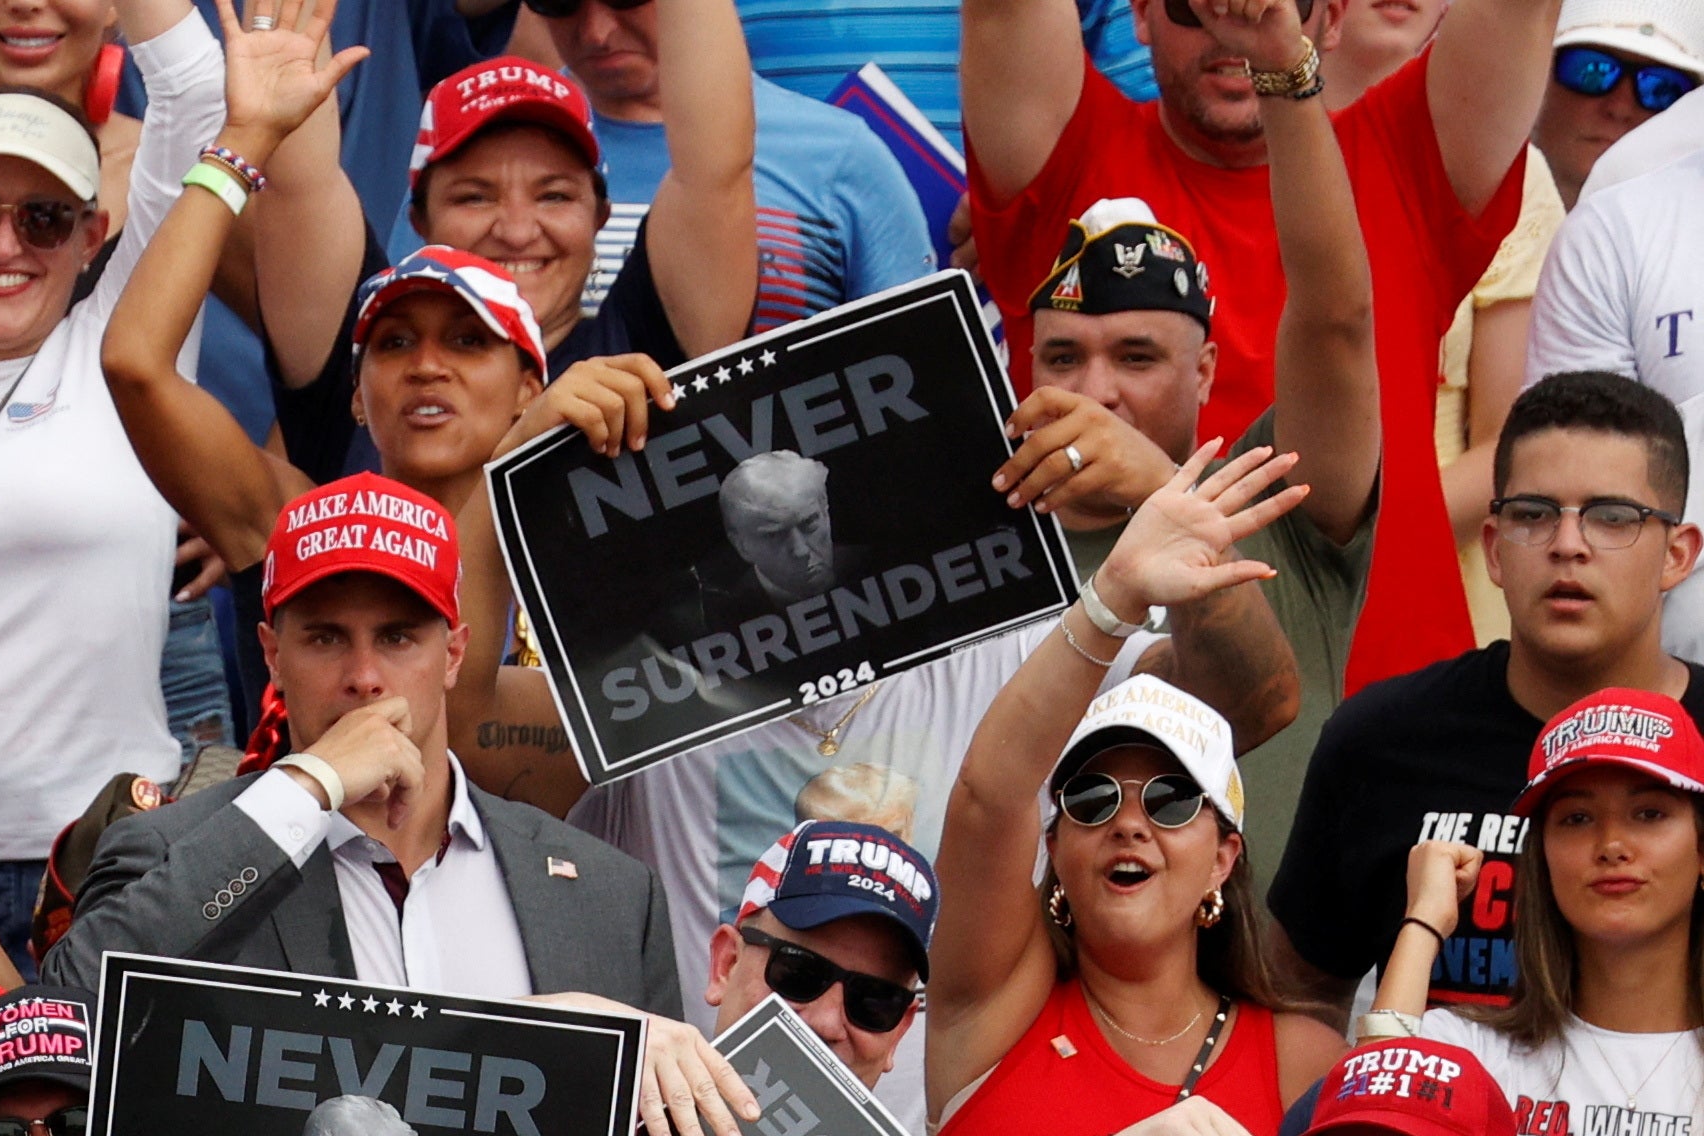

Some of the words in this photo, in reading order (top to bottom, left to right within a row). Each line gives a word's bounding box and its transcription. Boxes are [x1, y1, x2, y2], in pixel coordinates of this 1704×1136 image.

[456, 66, 570, 99] TRUMP
[566, 353, 930, 540] NEVER
[286, 492, 348, 533] MAKE
[349, 490, 449, 542] AMERICA
[296, 524, 367, 561] GREAT
[369, 526, 438, 571] AGAIN
[601, 532, 1034, 722] SURRENDER
[798, 659, 877, 706] 2024
[1122, 685, 1222, 738] AMERICA
[1142, 711, 1209, 758] AGAIN
[1541, 710, 1674, 759] TRUMP
[1570, 735, 1622, 753] AMERICA
[1623, 736, 1662, 753] GREAT
[1418, 811, 1474, 846] THE
[806, 838, 933, 904] TRUMP
[847, 873, 897, 902] 2024
[4, 1016, 49, 1040] FOR
[14, 1055, 54, 1067] AMERICA
[56, 1055, 87, 1064] GREAT
[1343, 1048, 1461, 1083] TRUMP
[1337, 1073, 1369, 1102] #1
[1368, 1071, 1412, 1098] #1
[1417, 1079, 1454, 1111] #1
